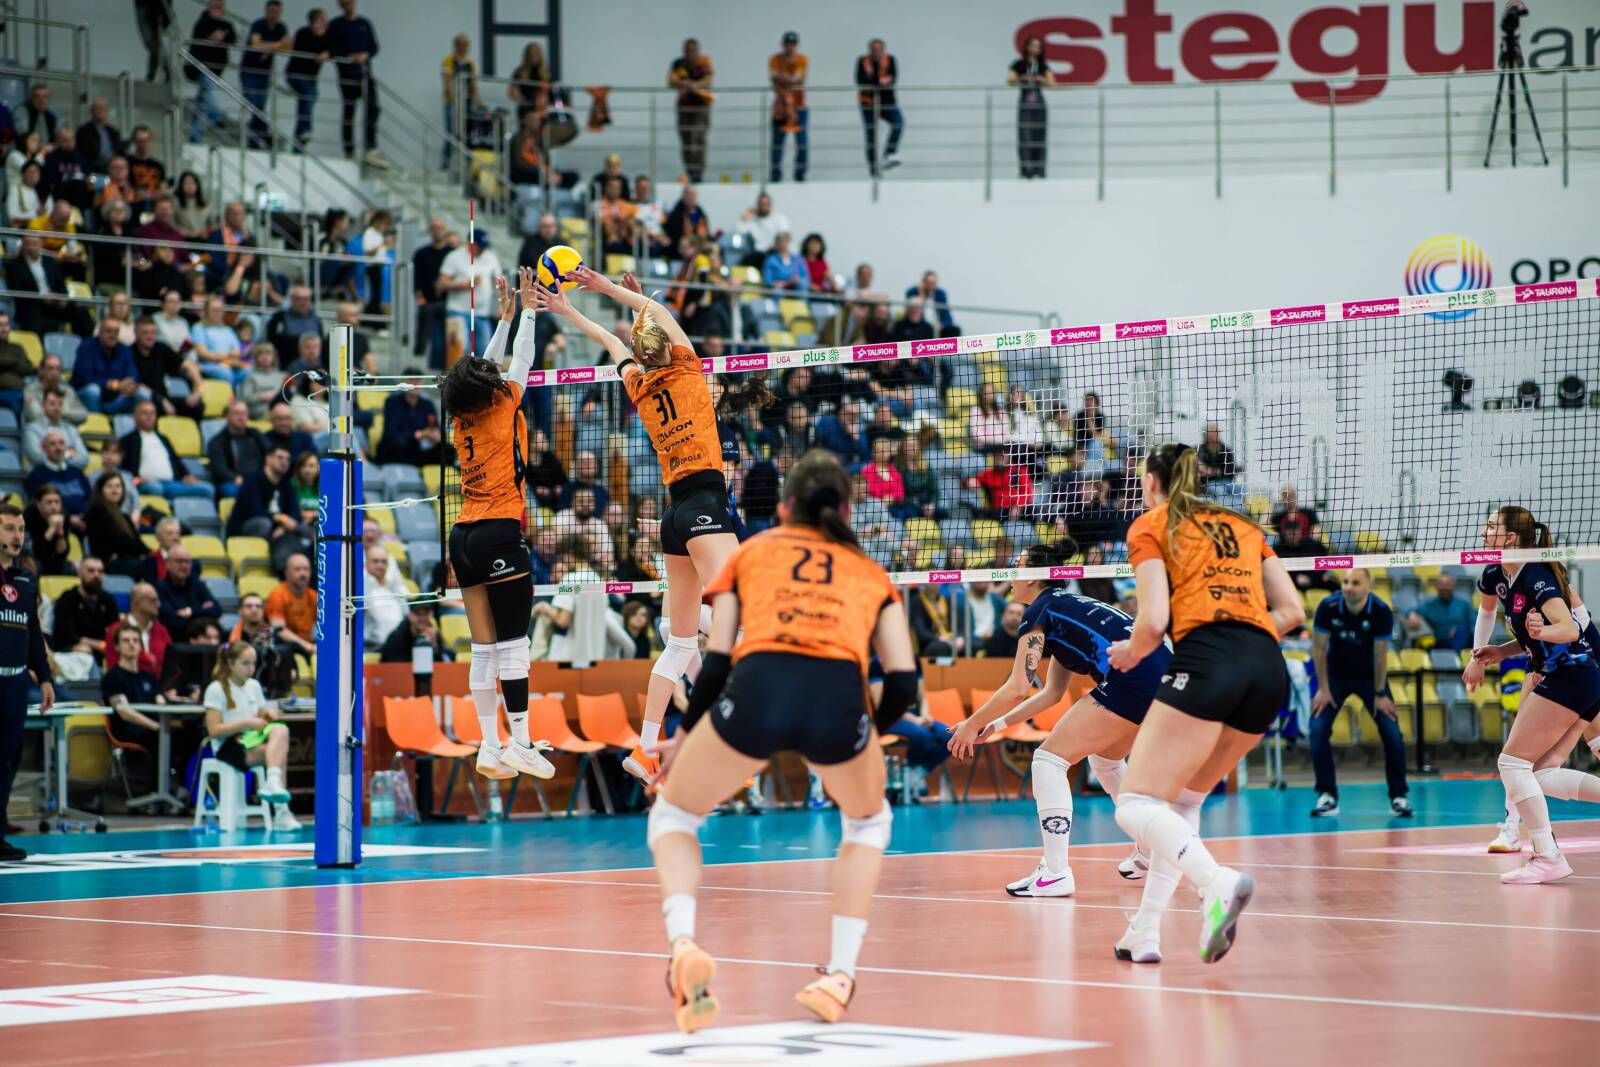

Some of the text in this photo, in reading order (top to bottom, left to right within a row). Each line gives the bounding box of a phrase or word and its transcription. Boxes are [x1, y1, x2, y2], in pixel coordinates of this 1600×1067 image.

[1014, 0, 1496, 106] stegu
[568, 371, 593, 380] TAURON
[602, 369, 616, 378] LIGA
[738, 358, 765, 367] TAURON
[776, 355, 791, 364] LIGA
[803, 350, 826, 364] plus
[866, 347, 895, 357] TAURON
[925, 342, 954, 352] TAURON
[966, 339, 983, 348] LIGA
[996, 334, 1021, 348] plus
[1067, 330, 1097, 341] TAURON
[1132, 324, 1163, 334] TAURON
[1177, 320, 1195, 330] LIGA
[1210, 314, 1238, 330] plus
[1287, 308, 1322, 320] TAURON
[1360, 303, 1395, 315] TAURON
[1447, 293, 1478, 309] plus
[1534, 286, 1572, 298] TAURON
[652, 388, 678, 427] 31
[463, 435, 474, 462] 3
[558, 585, 573, 595] plus
[938, 572, 960, 581] TAURON
[991, 569, 1009, 581] plus
[1061, 568, 1082, 577] TAURON
[1326, 559, 1351, 567] TAURON
[1389, 555, 1411, 566] plus
[1473, 553, 1499, 562] TAURON
[1540, 549, 1563, 561] plus
[791, 546, 834, 585] 23
